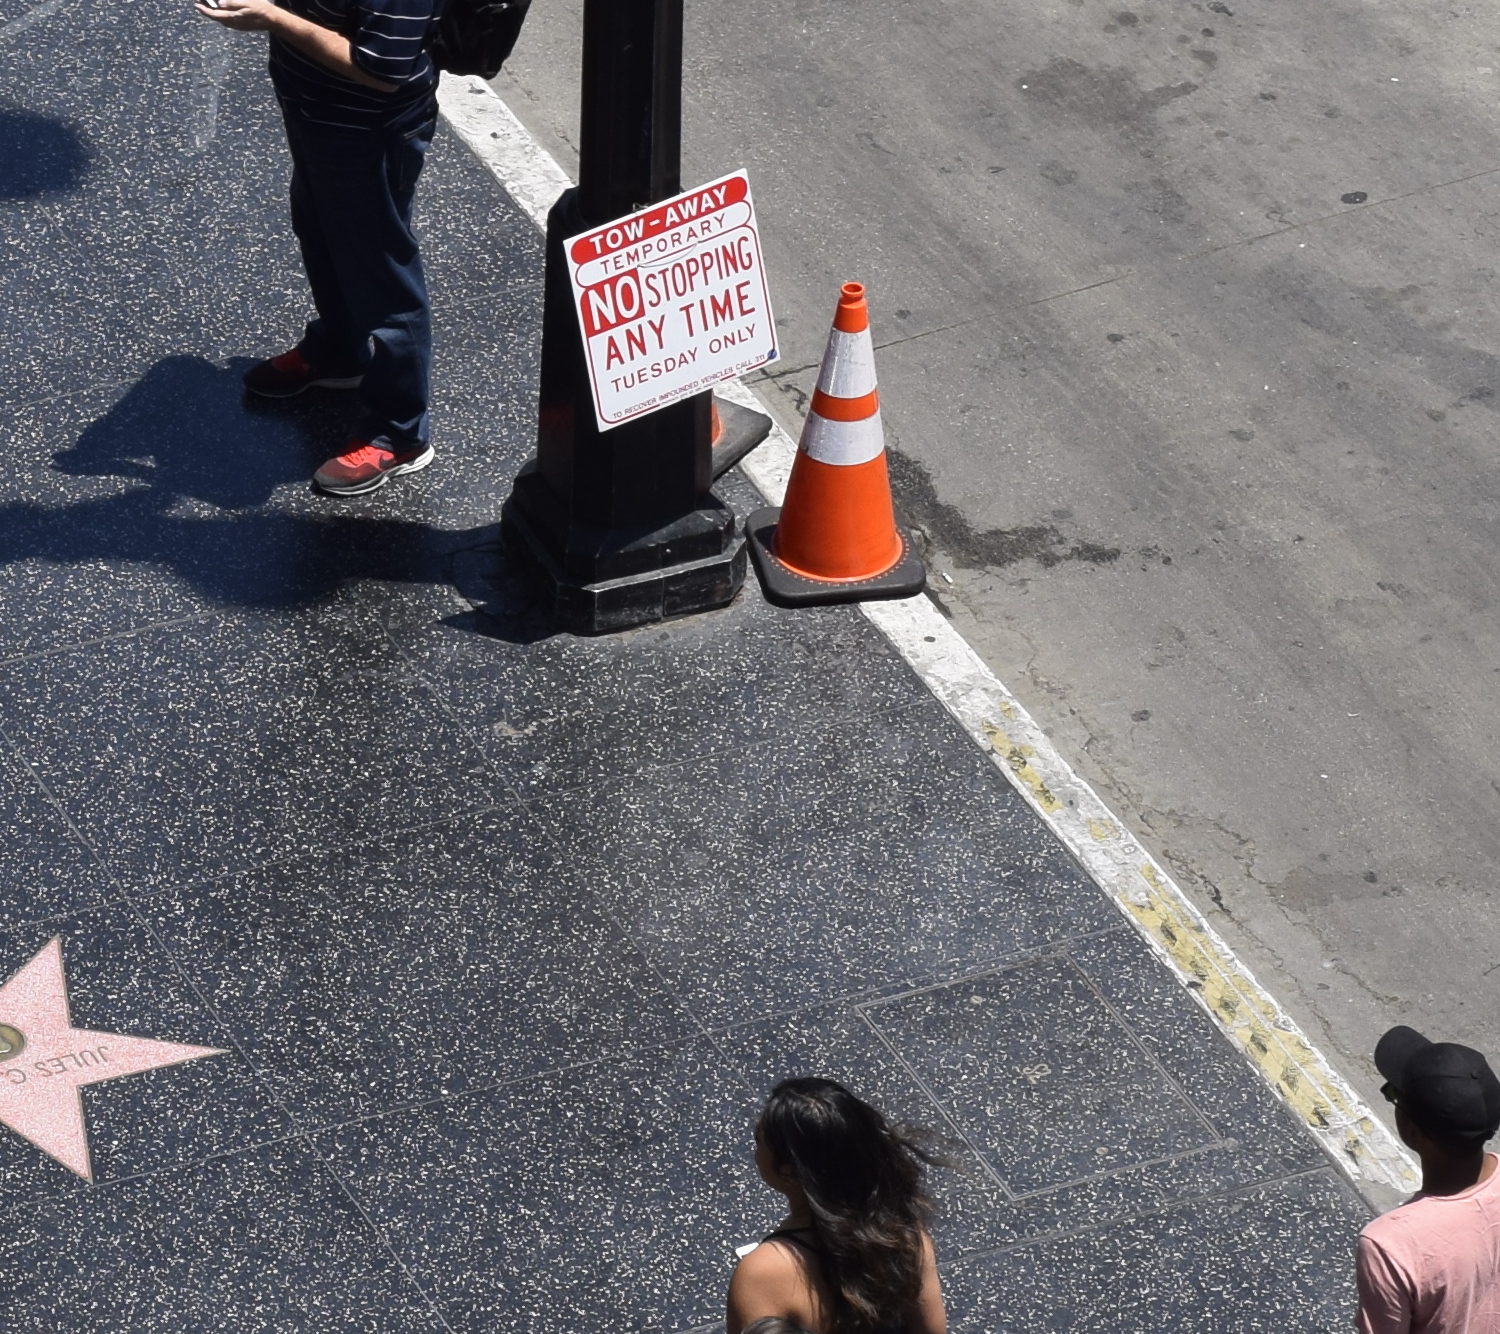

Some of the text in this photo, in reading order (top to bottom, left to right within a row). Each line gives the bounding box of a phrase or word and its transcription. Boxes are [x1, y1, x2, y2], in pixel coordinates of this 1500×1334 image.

[600, 212, 726, 275] TEMPORARY
[587, 235, 753, 331] NO STOPPING
[605, 280, 756, 371] ANY TIME
[610, 347, 698, 393] TUESDAY
[709, 323, 756, 355] ONLY
[613, 410, 623, 419] TO
[624, 397, 657, 415] RECOVER
[658, 380, 699, 402] IMPOUNDED
[700, 366, 734, 386] VEHICLES
[735, 358, 753, 371] CALL
[32, 1046, 111, 1079] JULES
